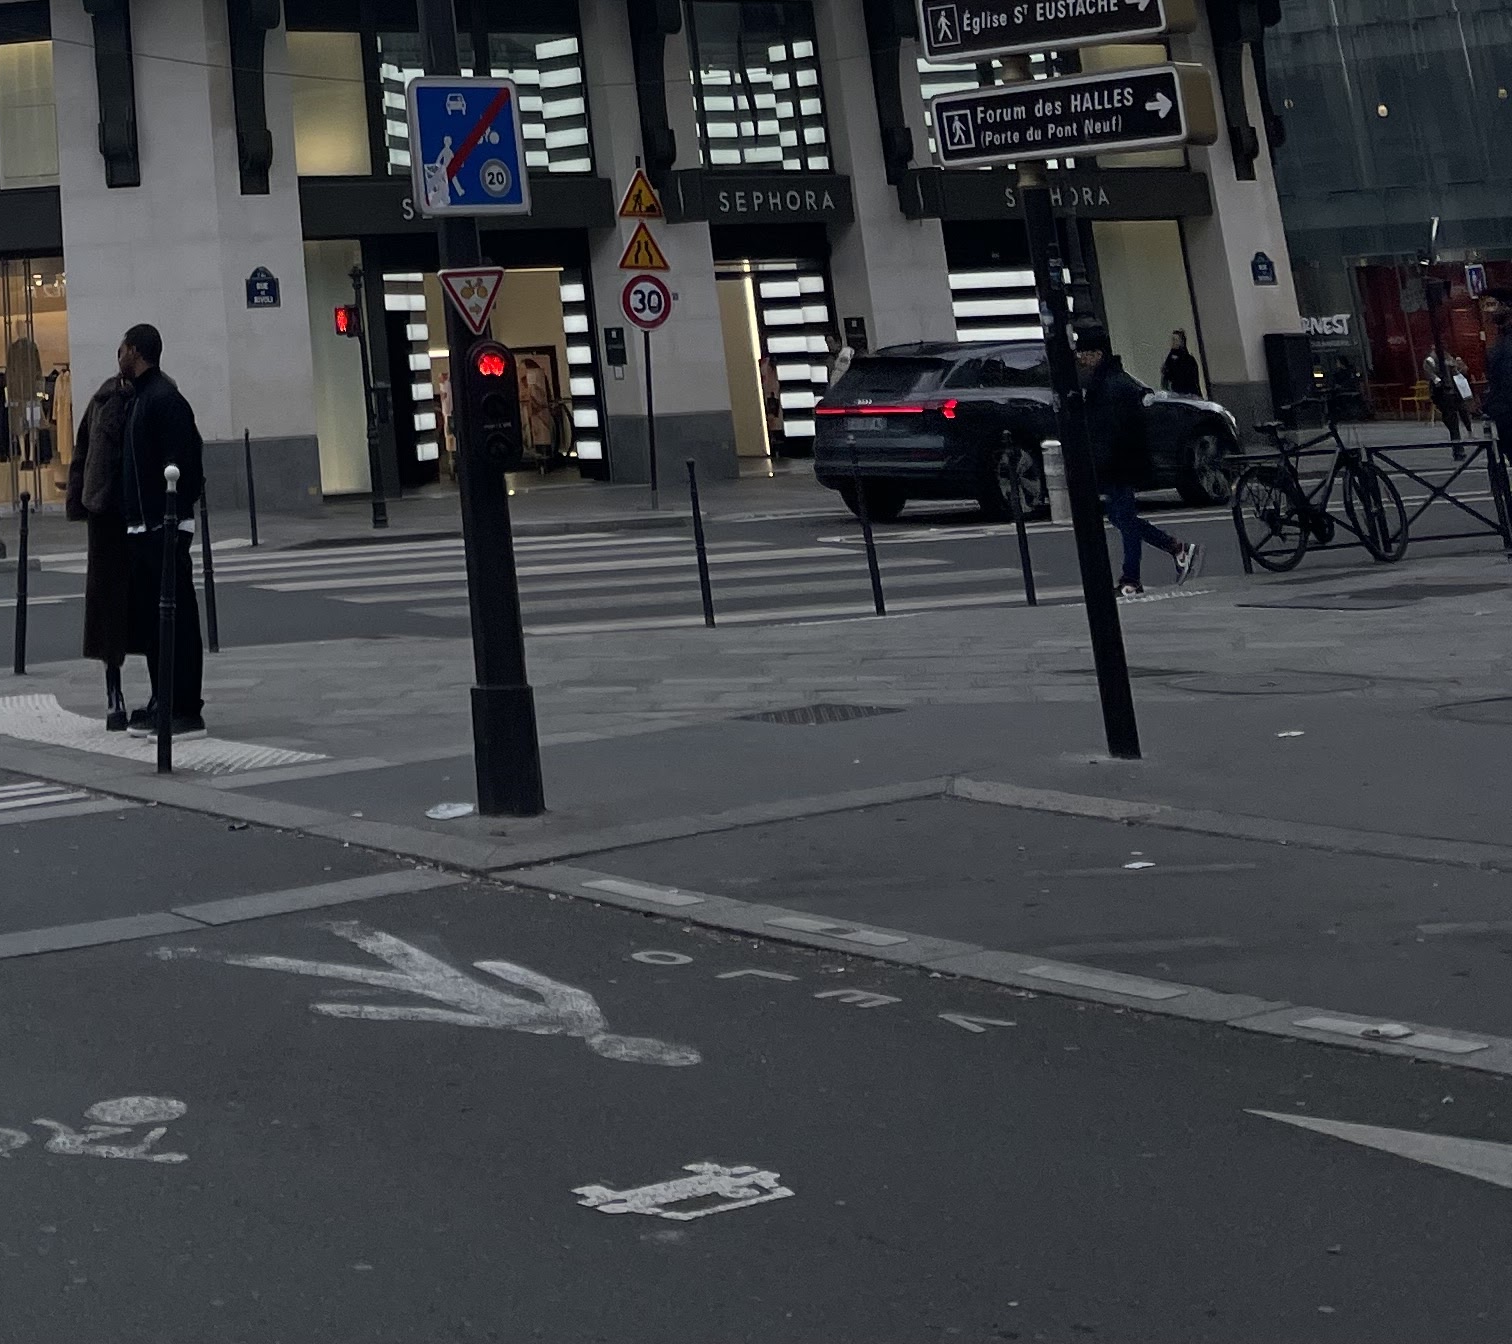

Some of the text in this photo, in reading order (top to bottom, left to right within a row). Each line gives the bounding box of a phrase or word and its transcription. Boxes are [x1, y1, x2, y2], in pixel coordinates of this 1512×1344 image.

[963, 10, 1008, 35] Église
[976, 87, 1134, 125] Forum des HALLES
[980, 114, 1123, 149] (Porte du Pont Neuf)
[487, 172, 505, 185] 20
[718, 190, 836, 213] SEPHORA
[1005, 186, 1110, 208] SHORA
[632, 289, 663, 314] 30
